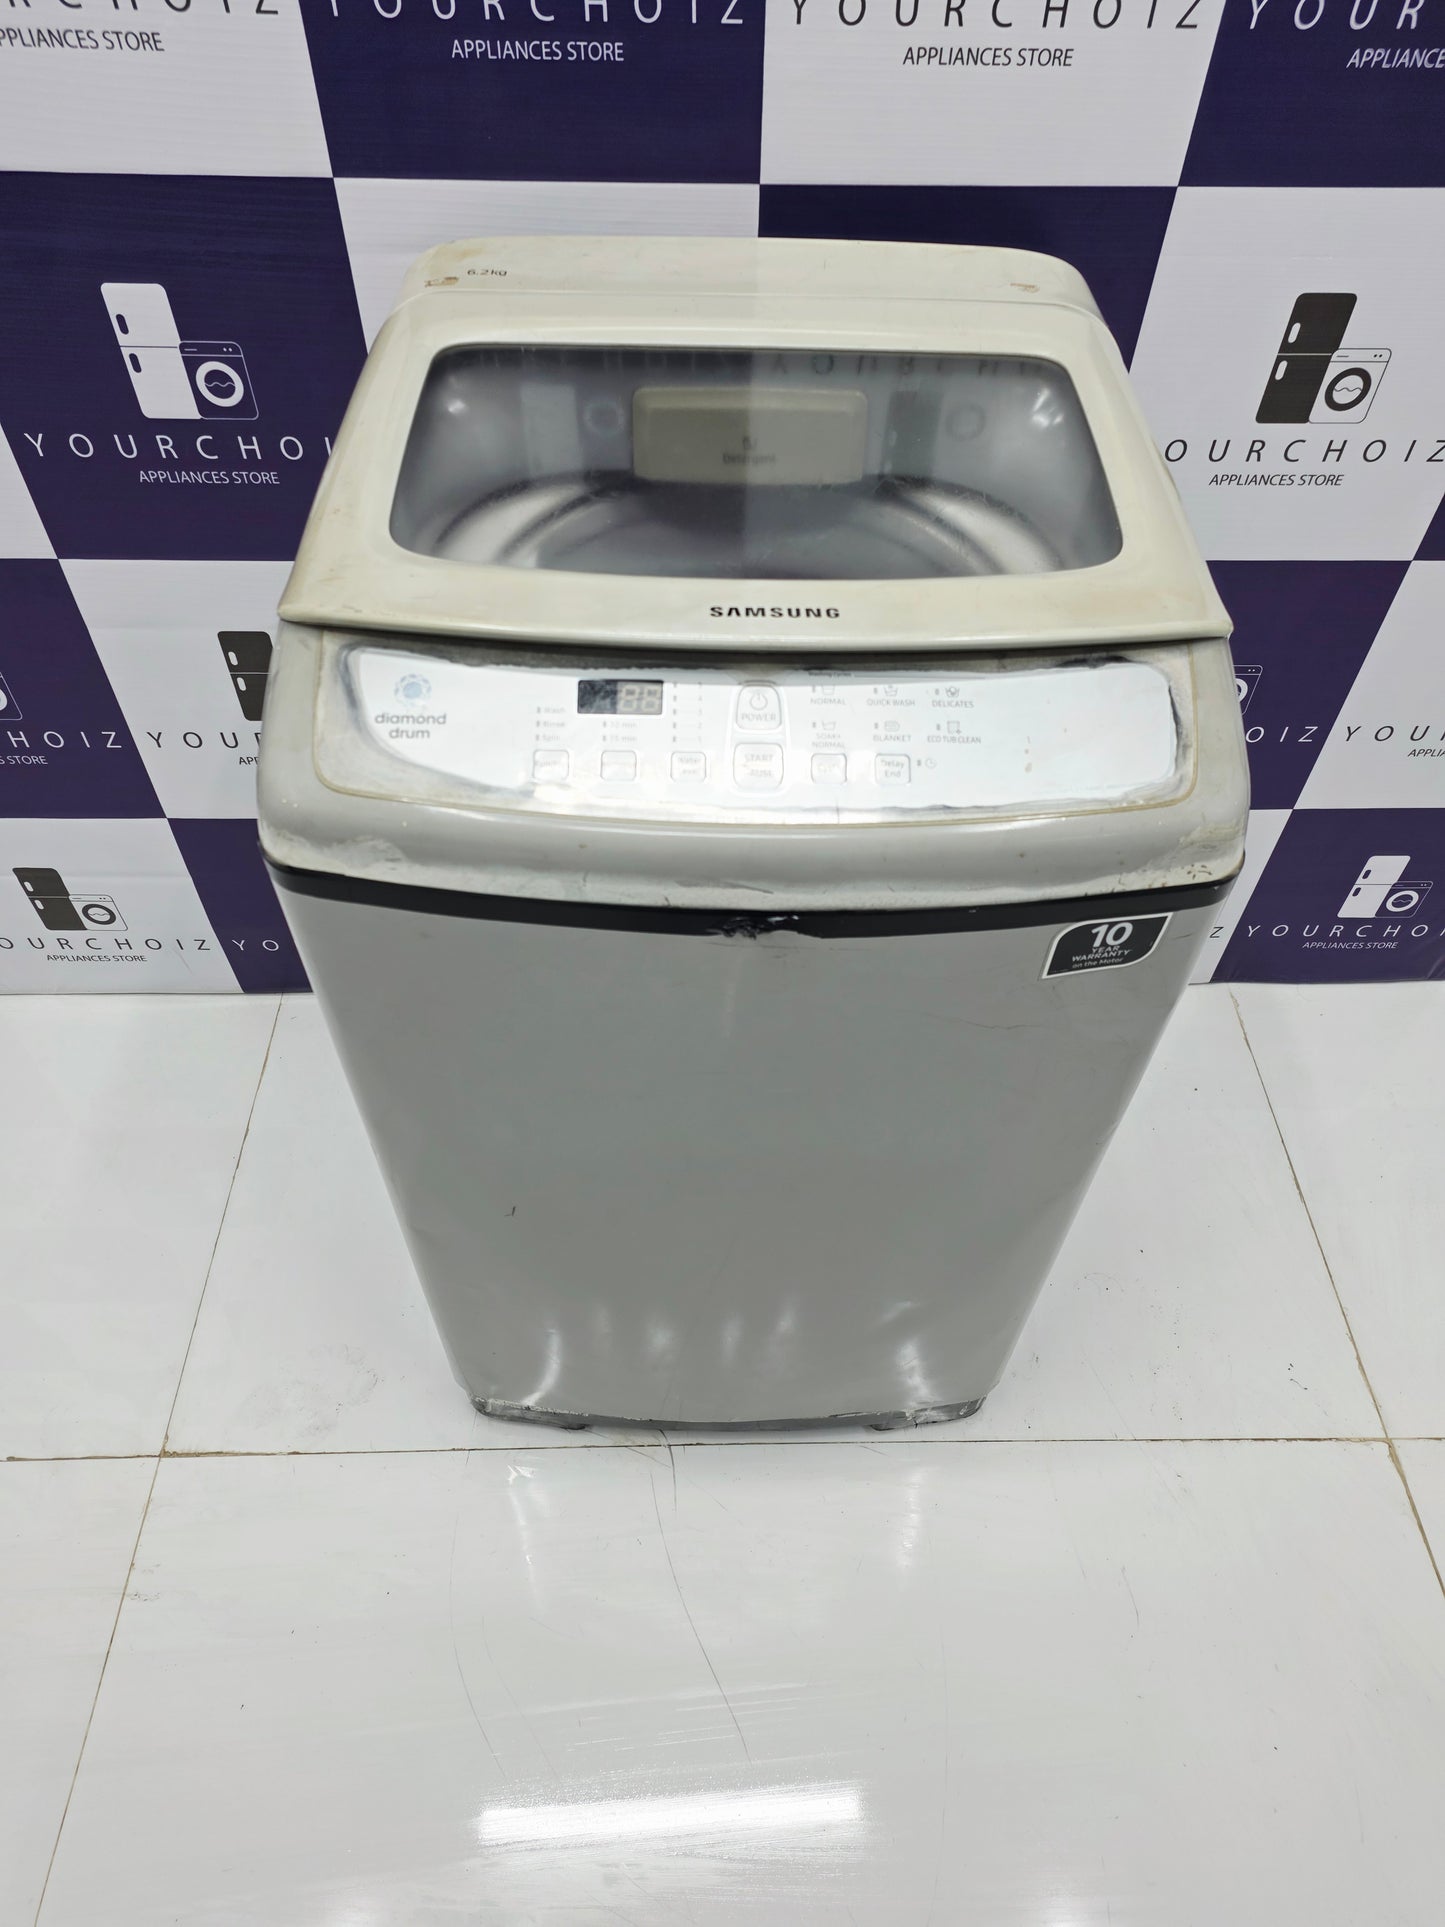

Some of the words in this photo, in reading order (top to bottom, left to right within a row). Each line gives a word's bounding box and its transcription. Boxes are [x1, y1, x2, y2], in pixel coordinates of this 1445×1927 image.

[793, 0, 1200, 28] YOURCHOIZ
[1250, 0, 1424, 30] YOUR
[0, 27, 98, 49] PPLIANCES
[103, 31, 164, 51] STORE
[452, 39, 561, 60] APPLIANCES
[567, 41, 624, 61] STORE
[903, 46, 1011, 66] APPLIANCES
[1016, 48, 1073, 67] STORE
[1164, 439, 1445, 462] OURCHOIZ
[139, 471, 230, 484] APPLIANCES
[234, 471, 280, 484] STORE
[1209, 474, 1296, 486] APPLIANCES
[1298, 474, 1344, 486] STORE
[709, 606, 840, 618] SAMSUNG
[867, 699, 892, 707] QUICK
[892, 699, 915, 707] WASH
[932, 700, 974, 708] DELICATES
[374, 713, 447, 725] diamond
[741, 713, 776, 721] POWER
[7, 731, 122, 748] HOIZ
[388, 728, 431, 739] drum
[873, 734, 912, 742] BLANKET
[927, 735, 942, 743] ECO
[943, 736, 958, 744] TUB
[958, 736, 982, 744] CLEAN
[1245, 726, 1318, 743] OIZ
[7, 755, 48, 764] STORE
[885, 769, 901, 778] End
[1091, 922, 1133, 948] 10
[0, 937, 211, 951] OURCHOIZ
[232, 939, 279, 951] YO
[1092, 945, 1120, 953] YEAR
[1365, 941, 1399, 949] STORE
[47, 954, 111, 962] APPLIANCES
[113, 954, 147, 962] STORE
[1072, 949, 1131, 962] WARRANTY
